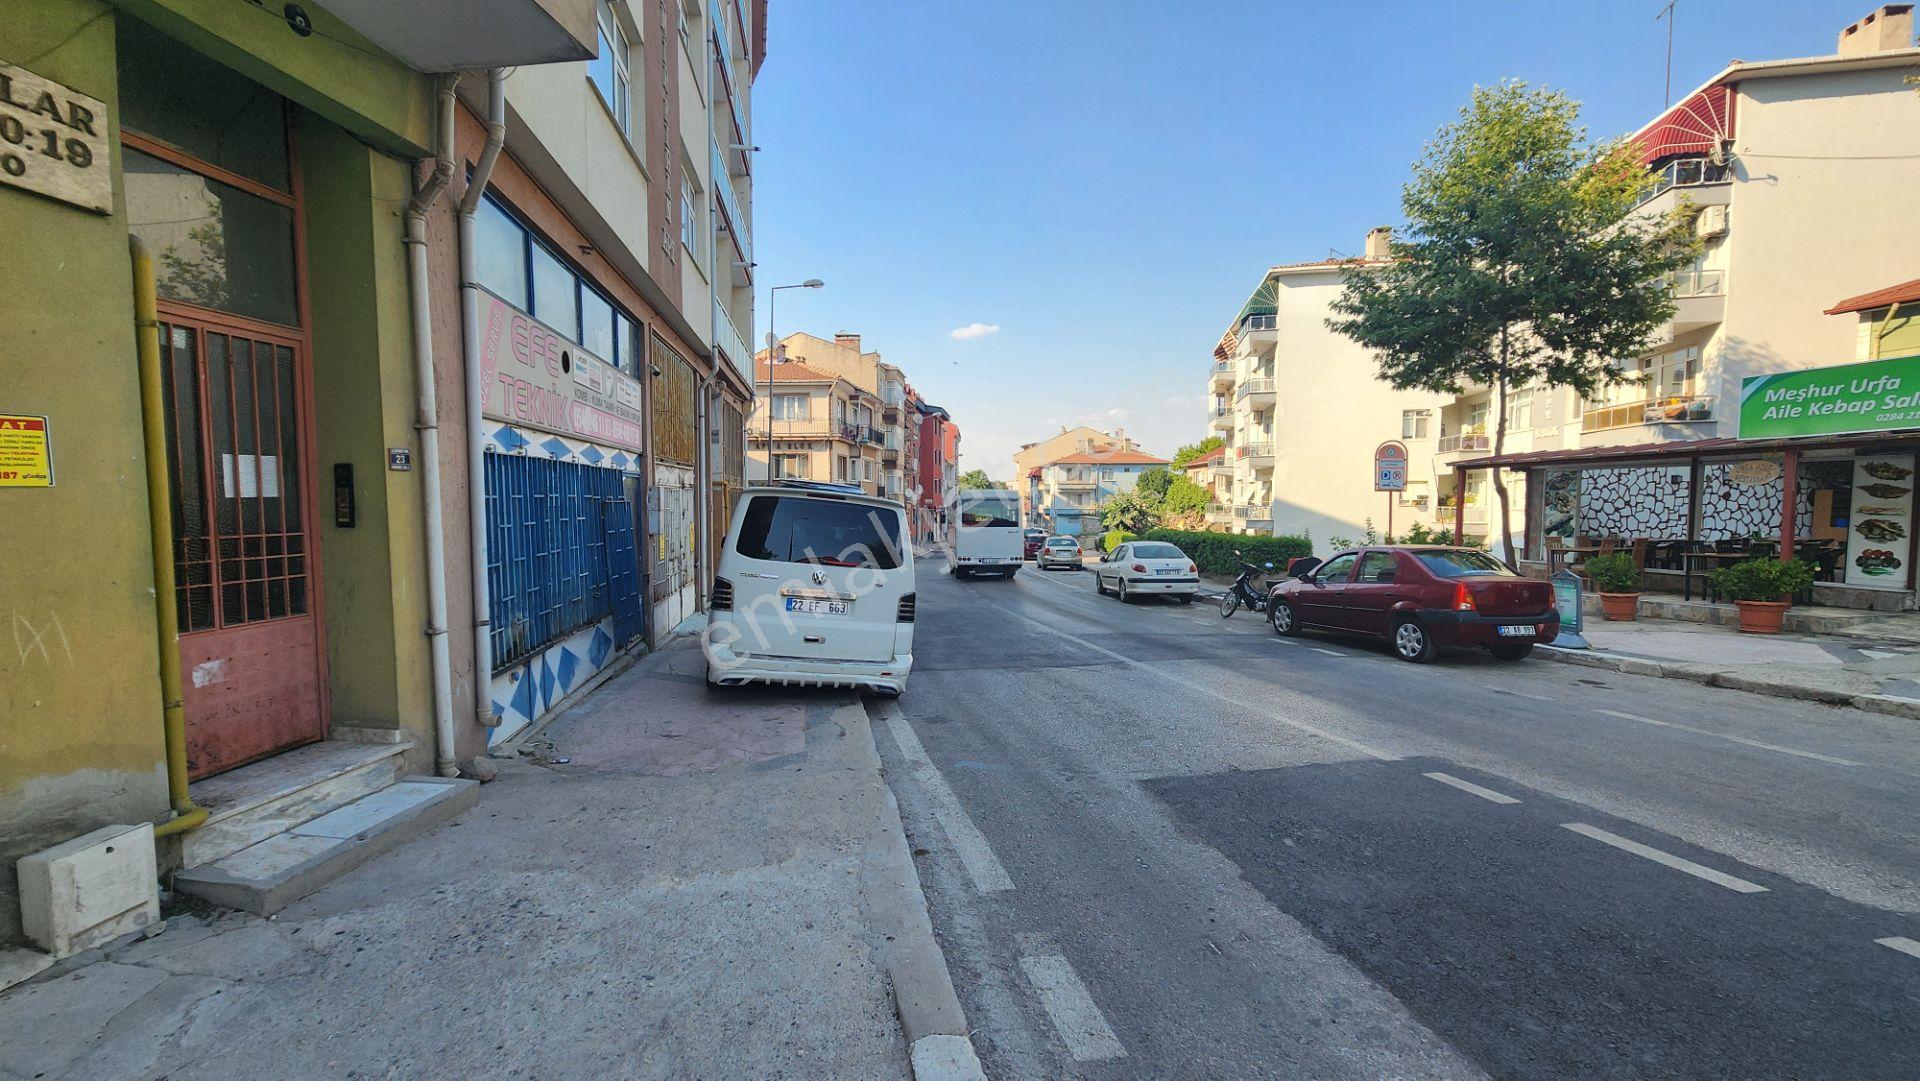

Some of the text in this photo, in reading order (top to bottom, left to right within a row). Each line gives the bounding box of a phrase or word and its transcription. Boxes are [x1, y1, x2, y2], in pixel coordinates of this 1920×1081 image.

[510, 315, 560, 379] EFE
[498, 371, 570, 432] TEKNİK
[1764, 375, 1902, 403] Meşhur Urfa
[1762, 392, 1920, 420] Aile Kebap Sal
[792, 600, 846, 613] 22 EF 663
